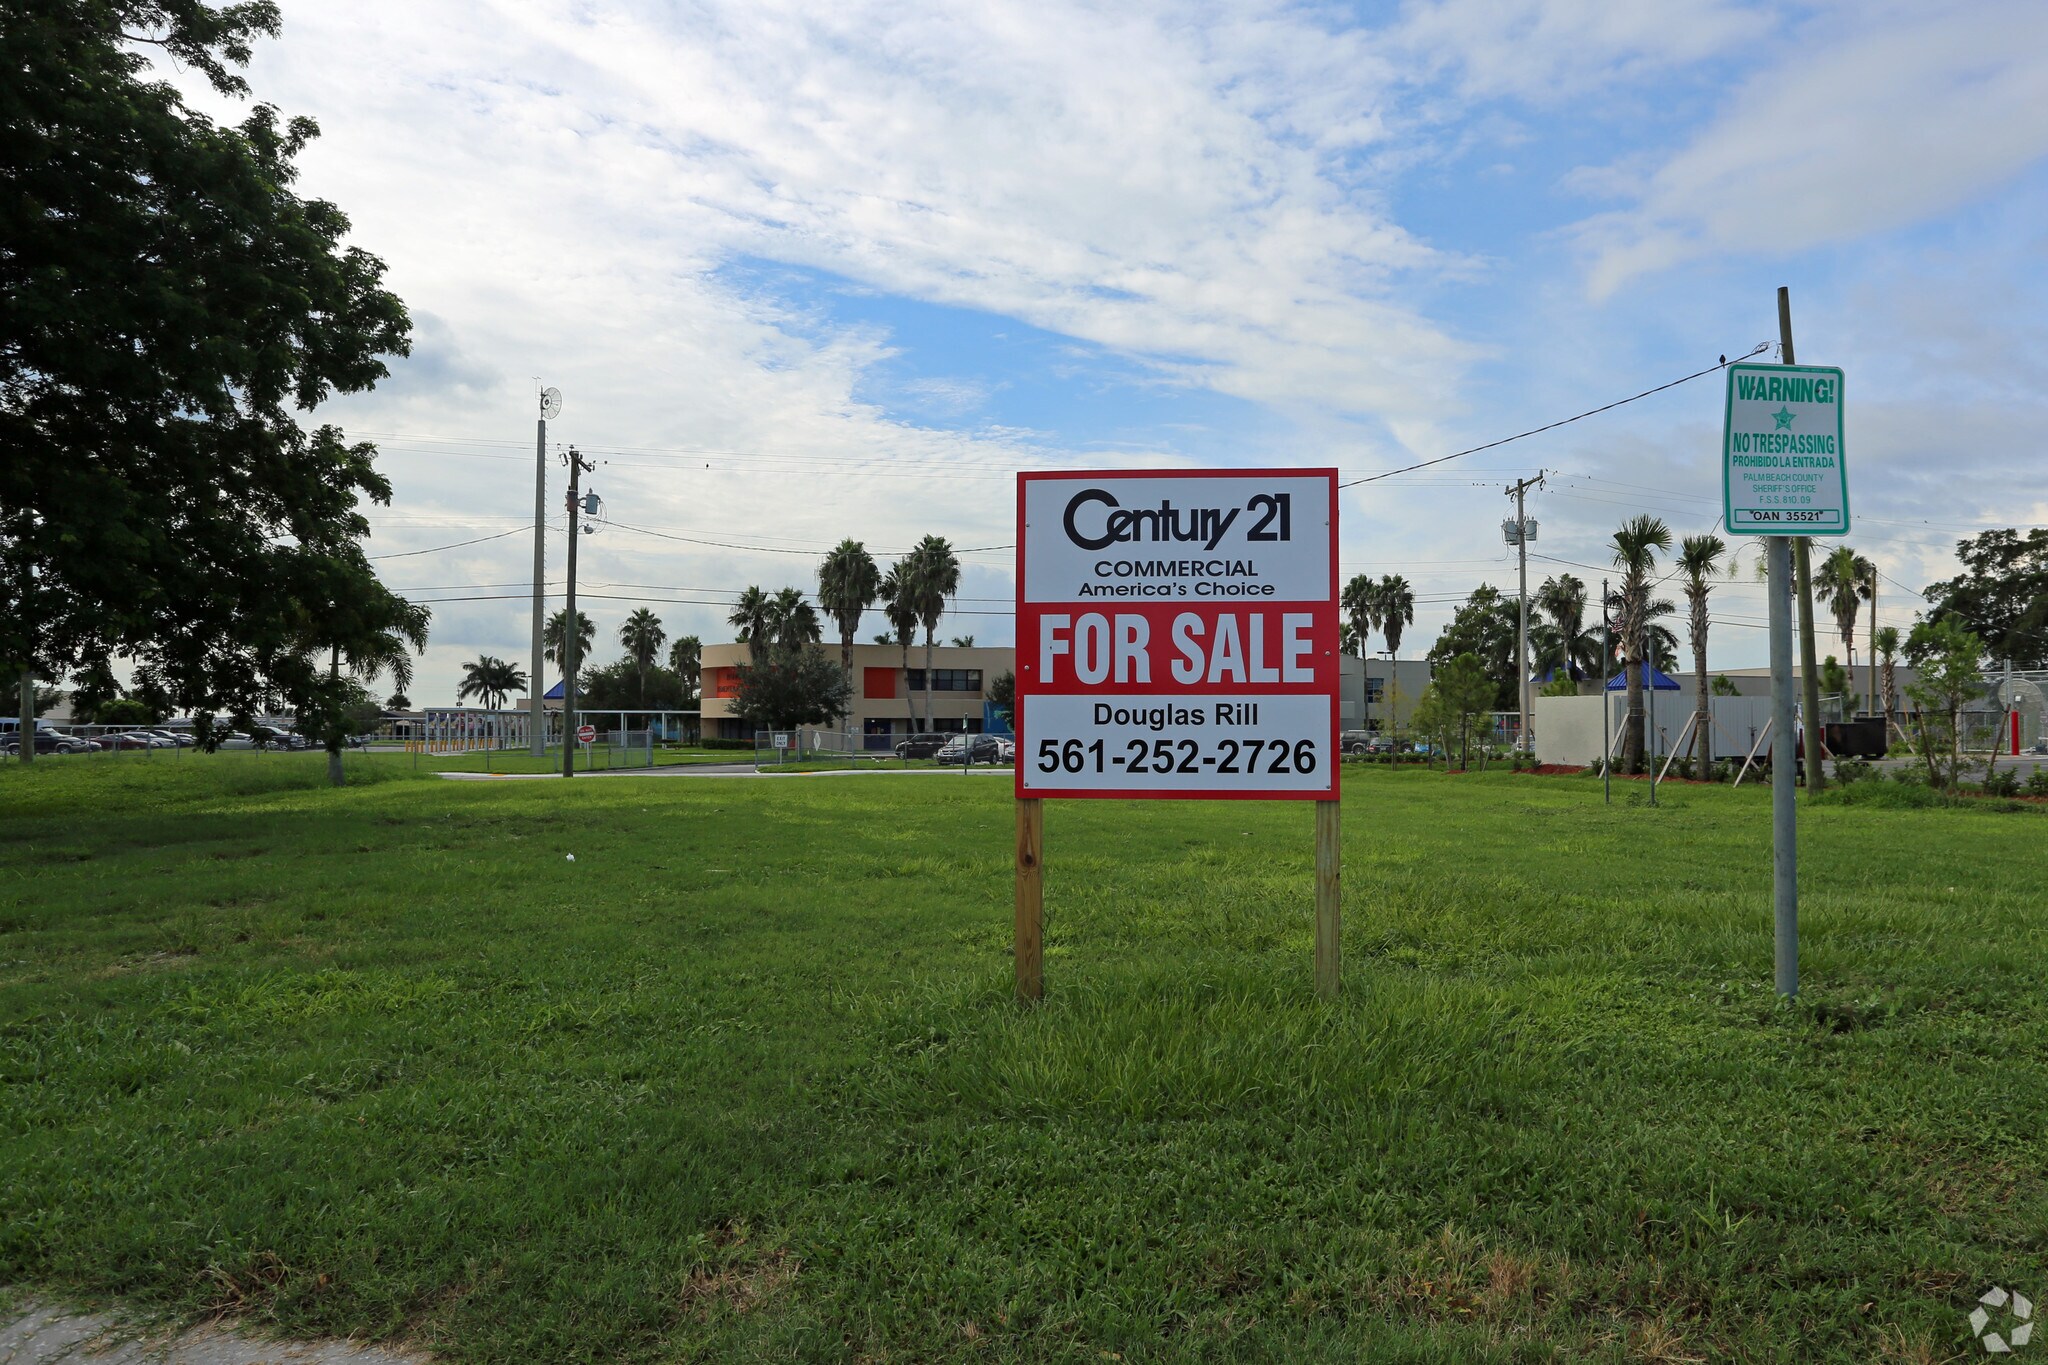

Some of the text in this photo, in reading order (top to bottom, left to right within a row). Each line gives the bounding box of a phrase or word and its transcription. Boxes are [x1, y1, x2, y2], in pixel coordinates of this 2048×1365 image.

[1737, 375, 1835, 404] WARNING!
[1733, 432, 1835, 454] NO TRESPASSING
[1732, 455, 1835, 468] PROHIBIDO LA ENTRADA
[1743, 473, 1824, 482] PALM BEACH COUNTY
[1752, 484, 1817, 493] SHERIFF'S OFFICE
[1063, 488, 1291, 551] Century 21
[1753, 511, 1820, 521] OAN 35521
[1094, 559, 1259, 577] COMMERCIAL
[1078, 581, 1276, 597] America's Choice
[1039, 611, 1315, 685] FOR SALE
[1093, 702, 1258, 731] Douglas Rill
[1038, 738, 1317, 774] 561-252-2726
